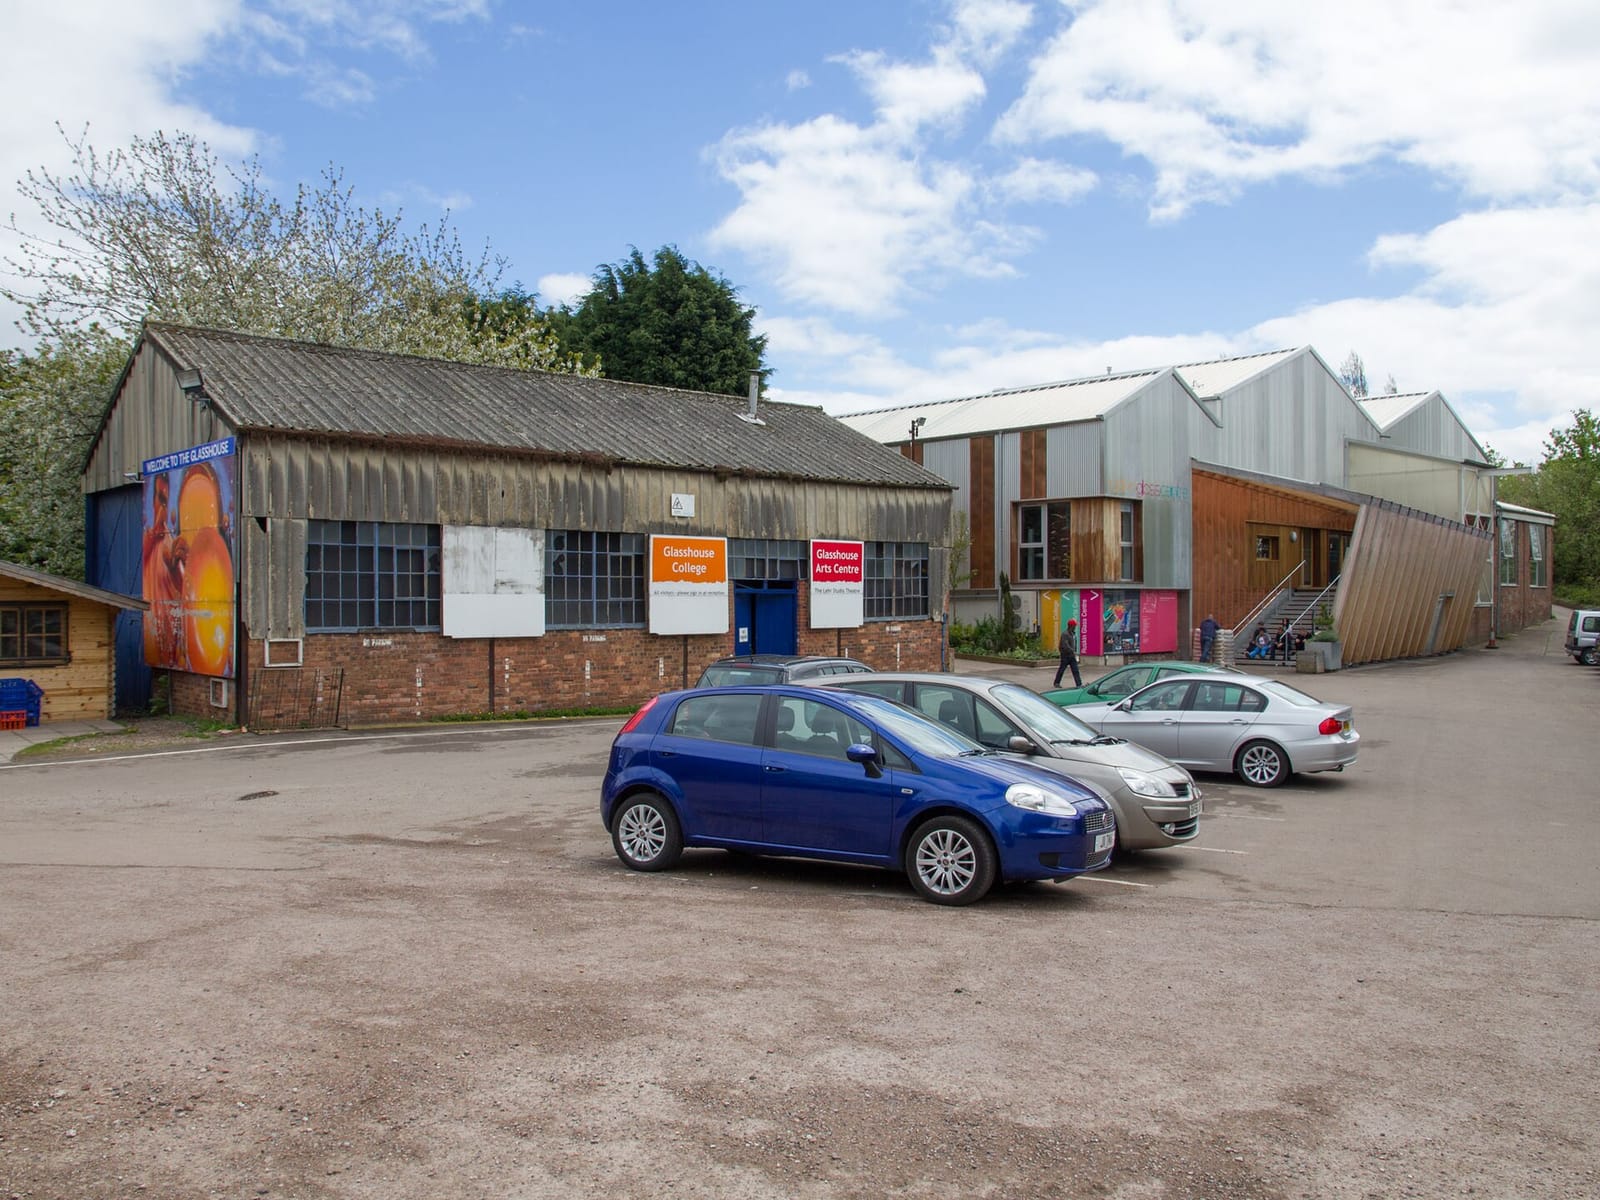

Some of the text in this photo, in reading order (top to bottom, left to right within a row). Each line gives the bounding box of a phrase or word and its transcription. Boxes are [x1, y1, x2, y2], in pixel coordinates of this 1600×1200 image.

[146, 440, 229, 473] WELCOME TO THE GLASSHOUSE
[663, 546, 715, 558] Glasshouse
[816, 549, 859, 560] Glasshouse
[672, 562, 707, 576] College
[815, 563, 860, 574] Arts Centre
